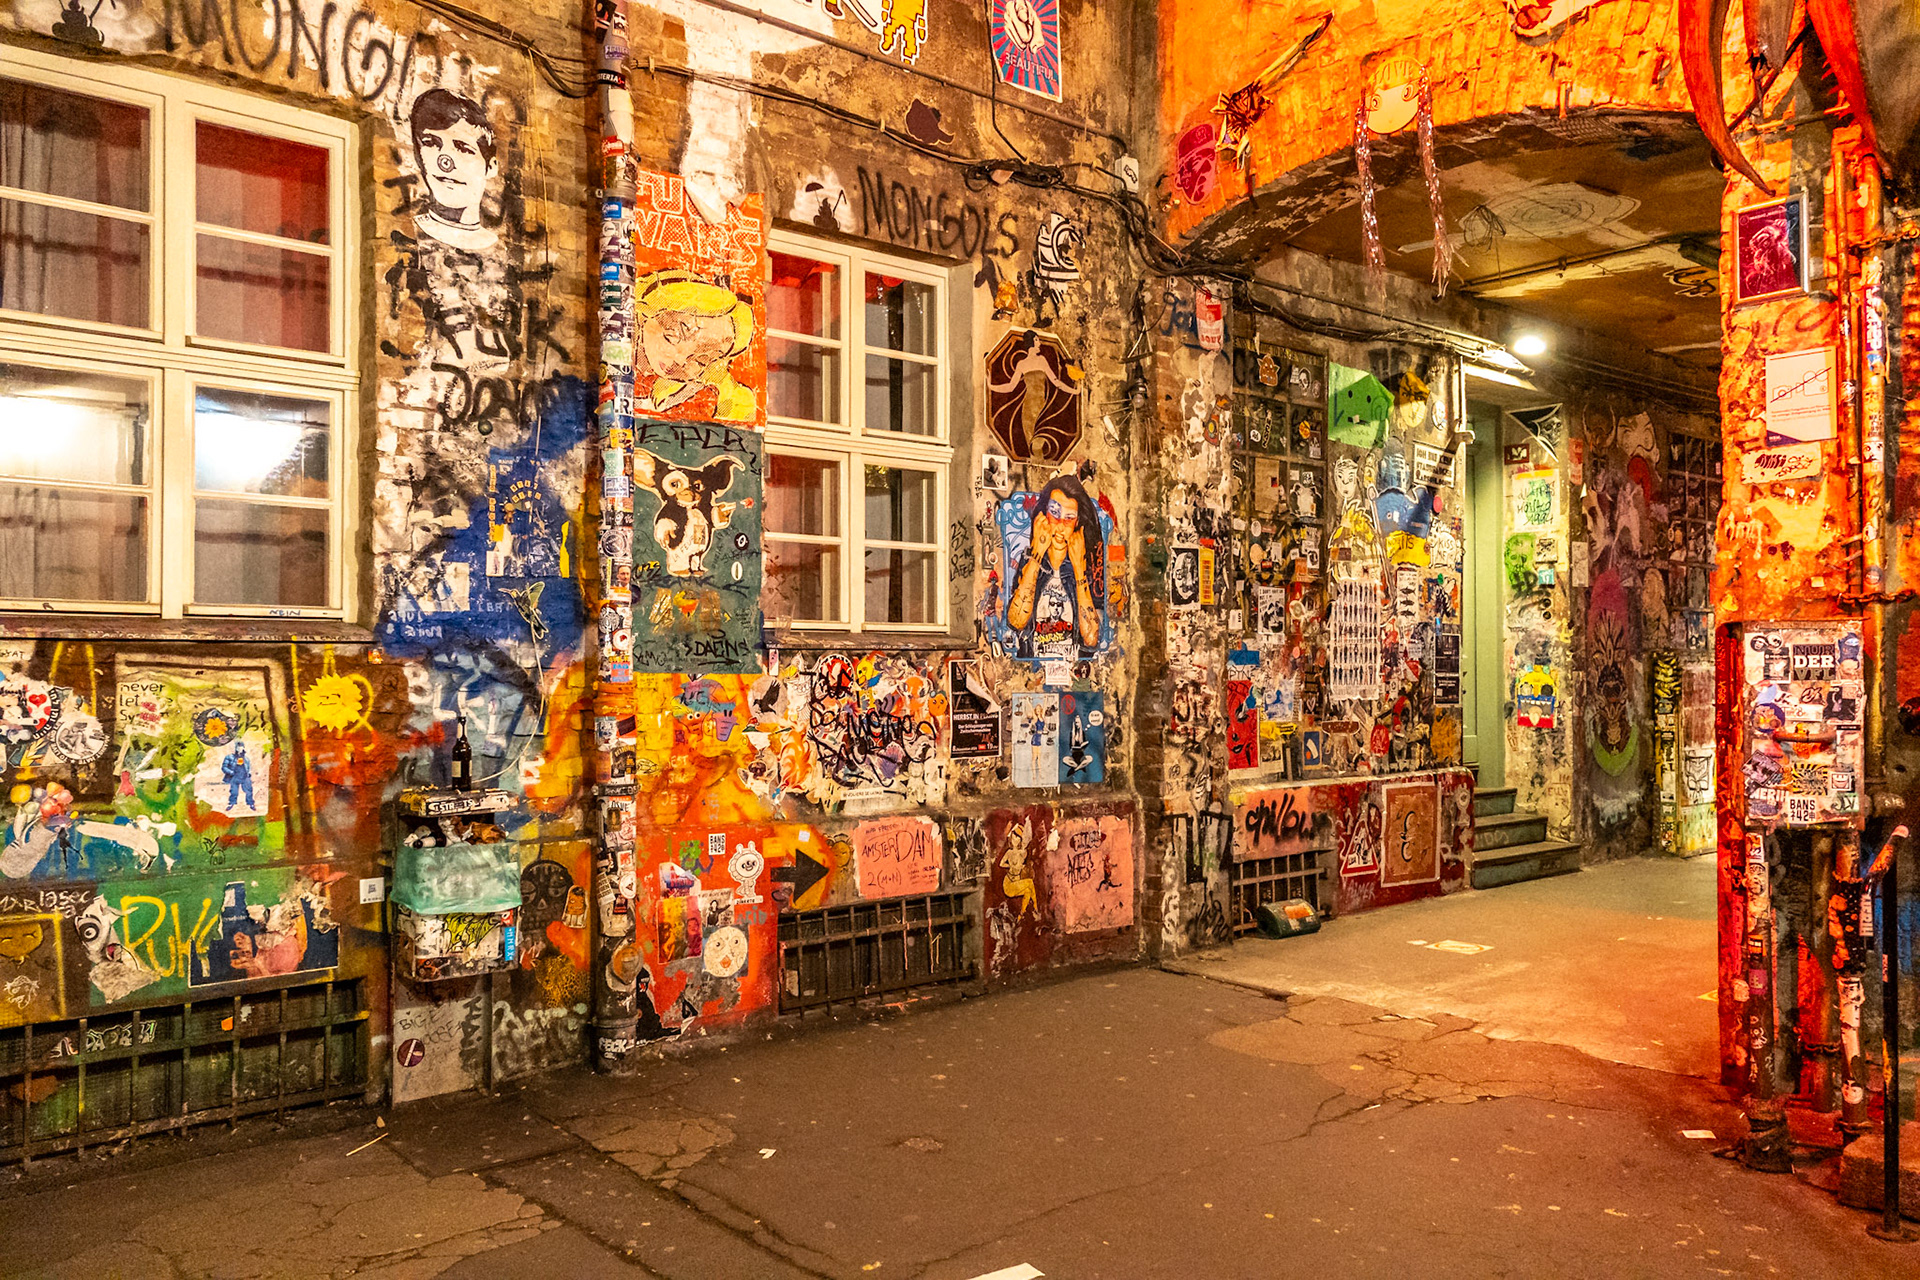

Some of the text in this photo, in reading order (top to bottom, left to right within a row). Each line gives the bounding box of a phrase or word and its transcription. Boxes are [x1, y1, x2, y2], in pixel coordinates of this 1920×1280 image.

[1004, 51, 1057, 83] BEAUTIFUL
[857, 166, 1018, 258] MONGOLS
[269, 609, 301, 620] NEIN
[1794, 645, 1835, 655] NUR
[1794, 655, 1835, 668] DER
[1794, 668, 1835, 680] VFL
[120, 683, 166, 692] never
[120, 695, 139, 706] let
[1789, 799, 1816, 810] BANS
[862, 829, 935, 863] AMSTERDAM
